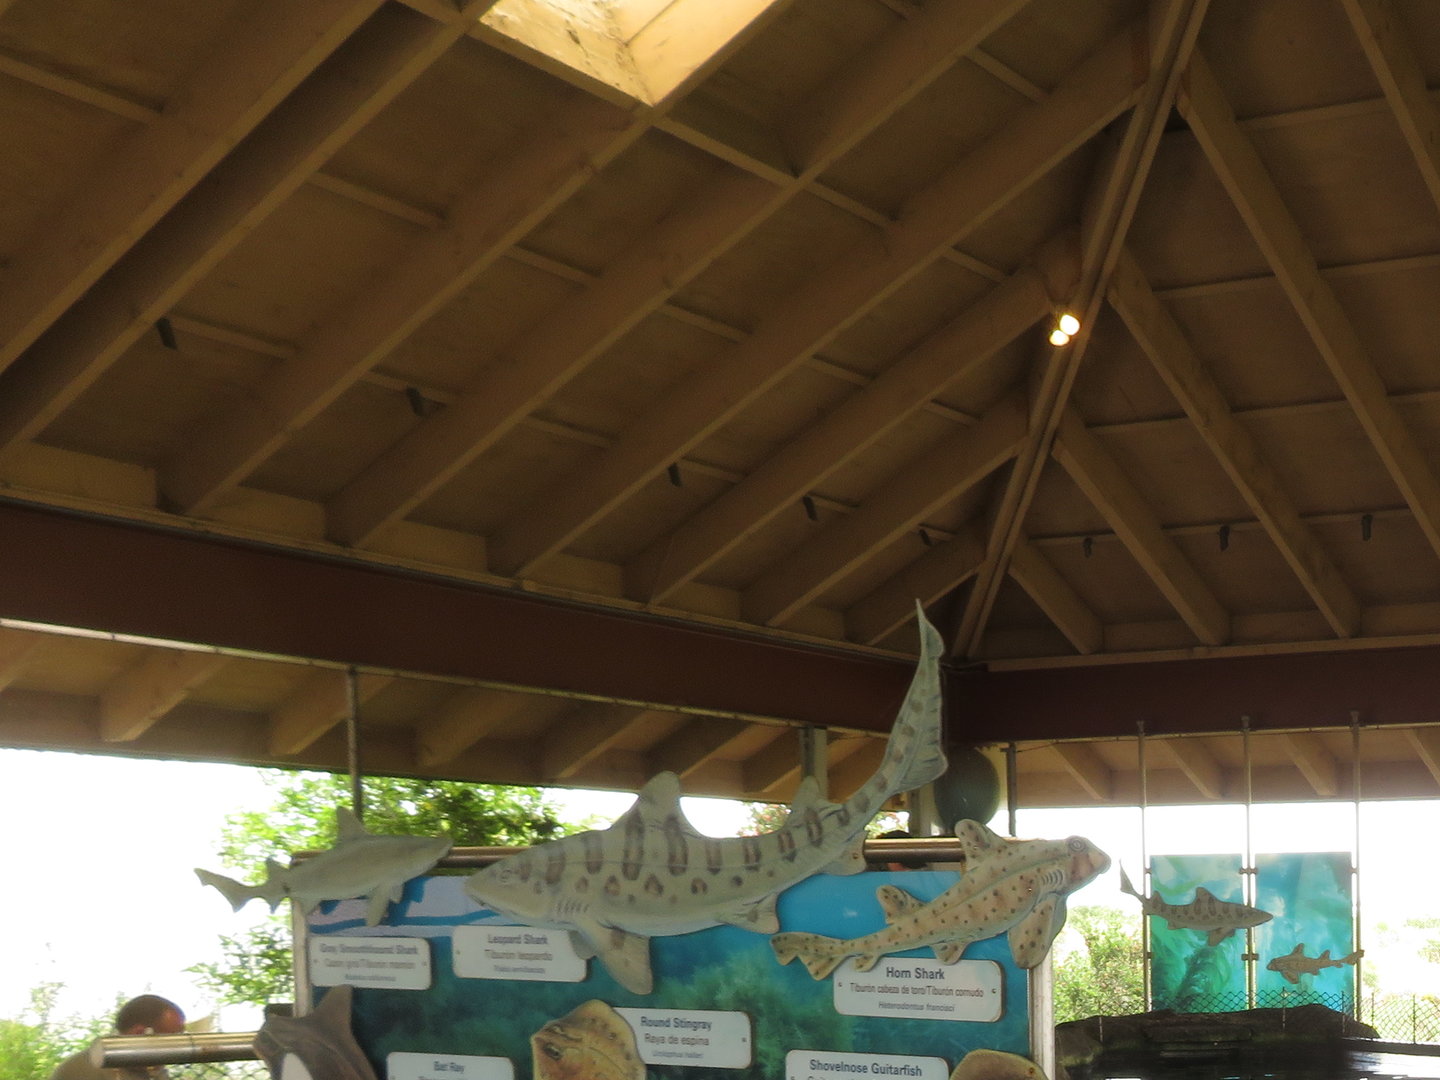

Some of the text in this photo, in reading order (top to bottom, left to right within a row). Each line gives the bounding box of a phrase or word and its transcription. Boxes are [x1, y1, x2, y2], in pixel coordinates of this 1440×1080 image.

[886, 966, 946, 980] Horn Shark
[640, 1016, 713, 1032] Round Stingray
[809, 1058, 923, 1077] Shovelnose Guitarfish
